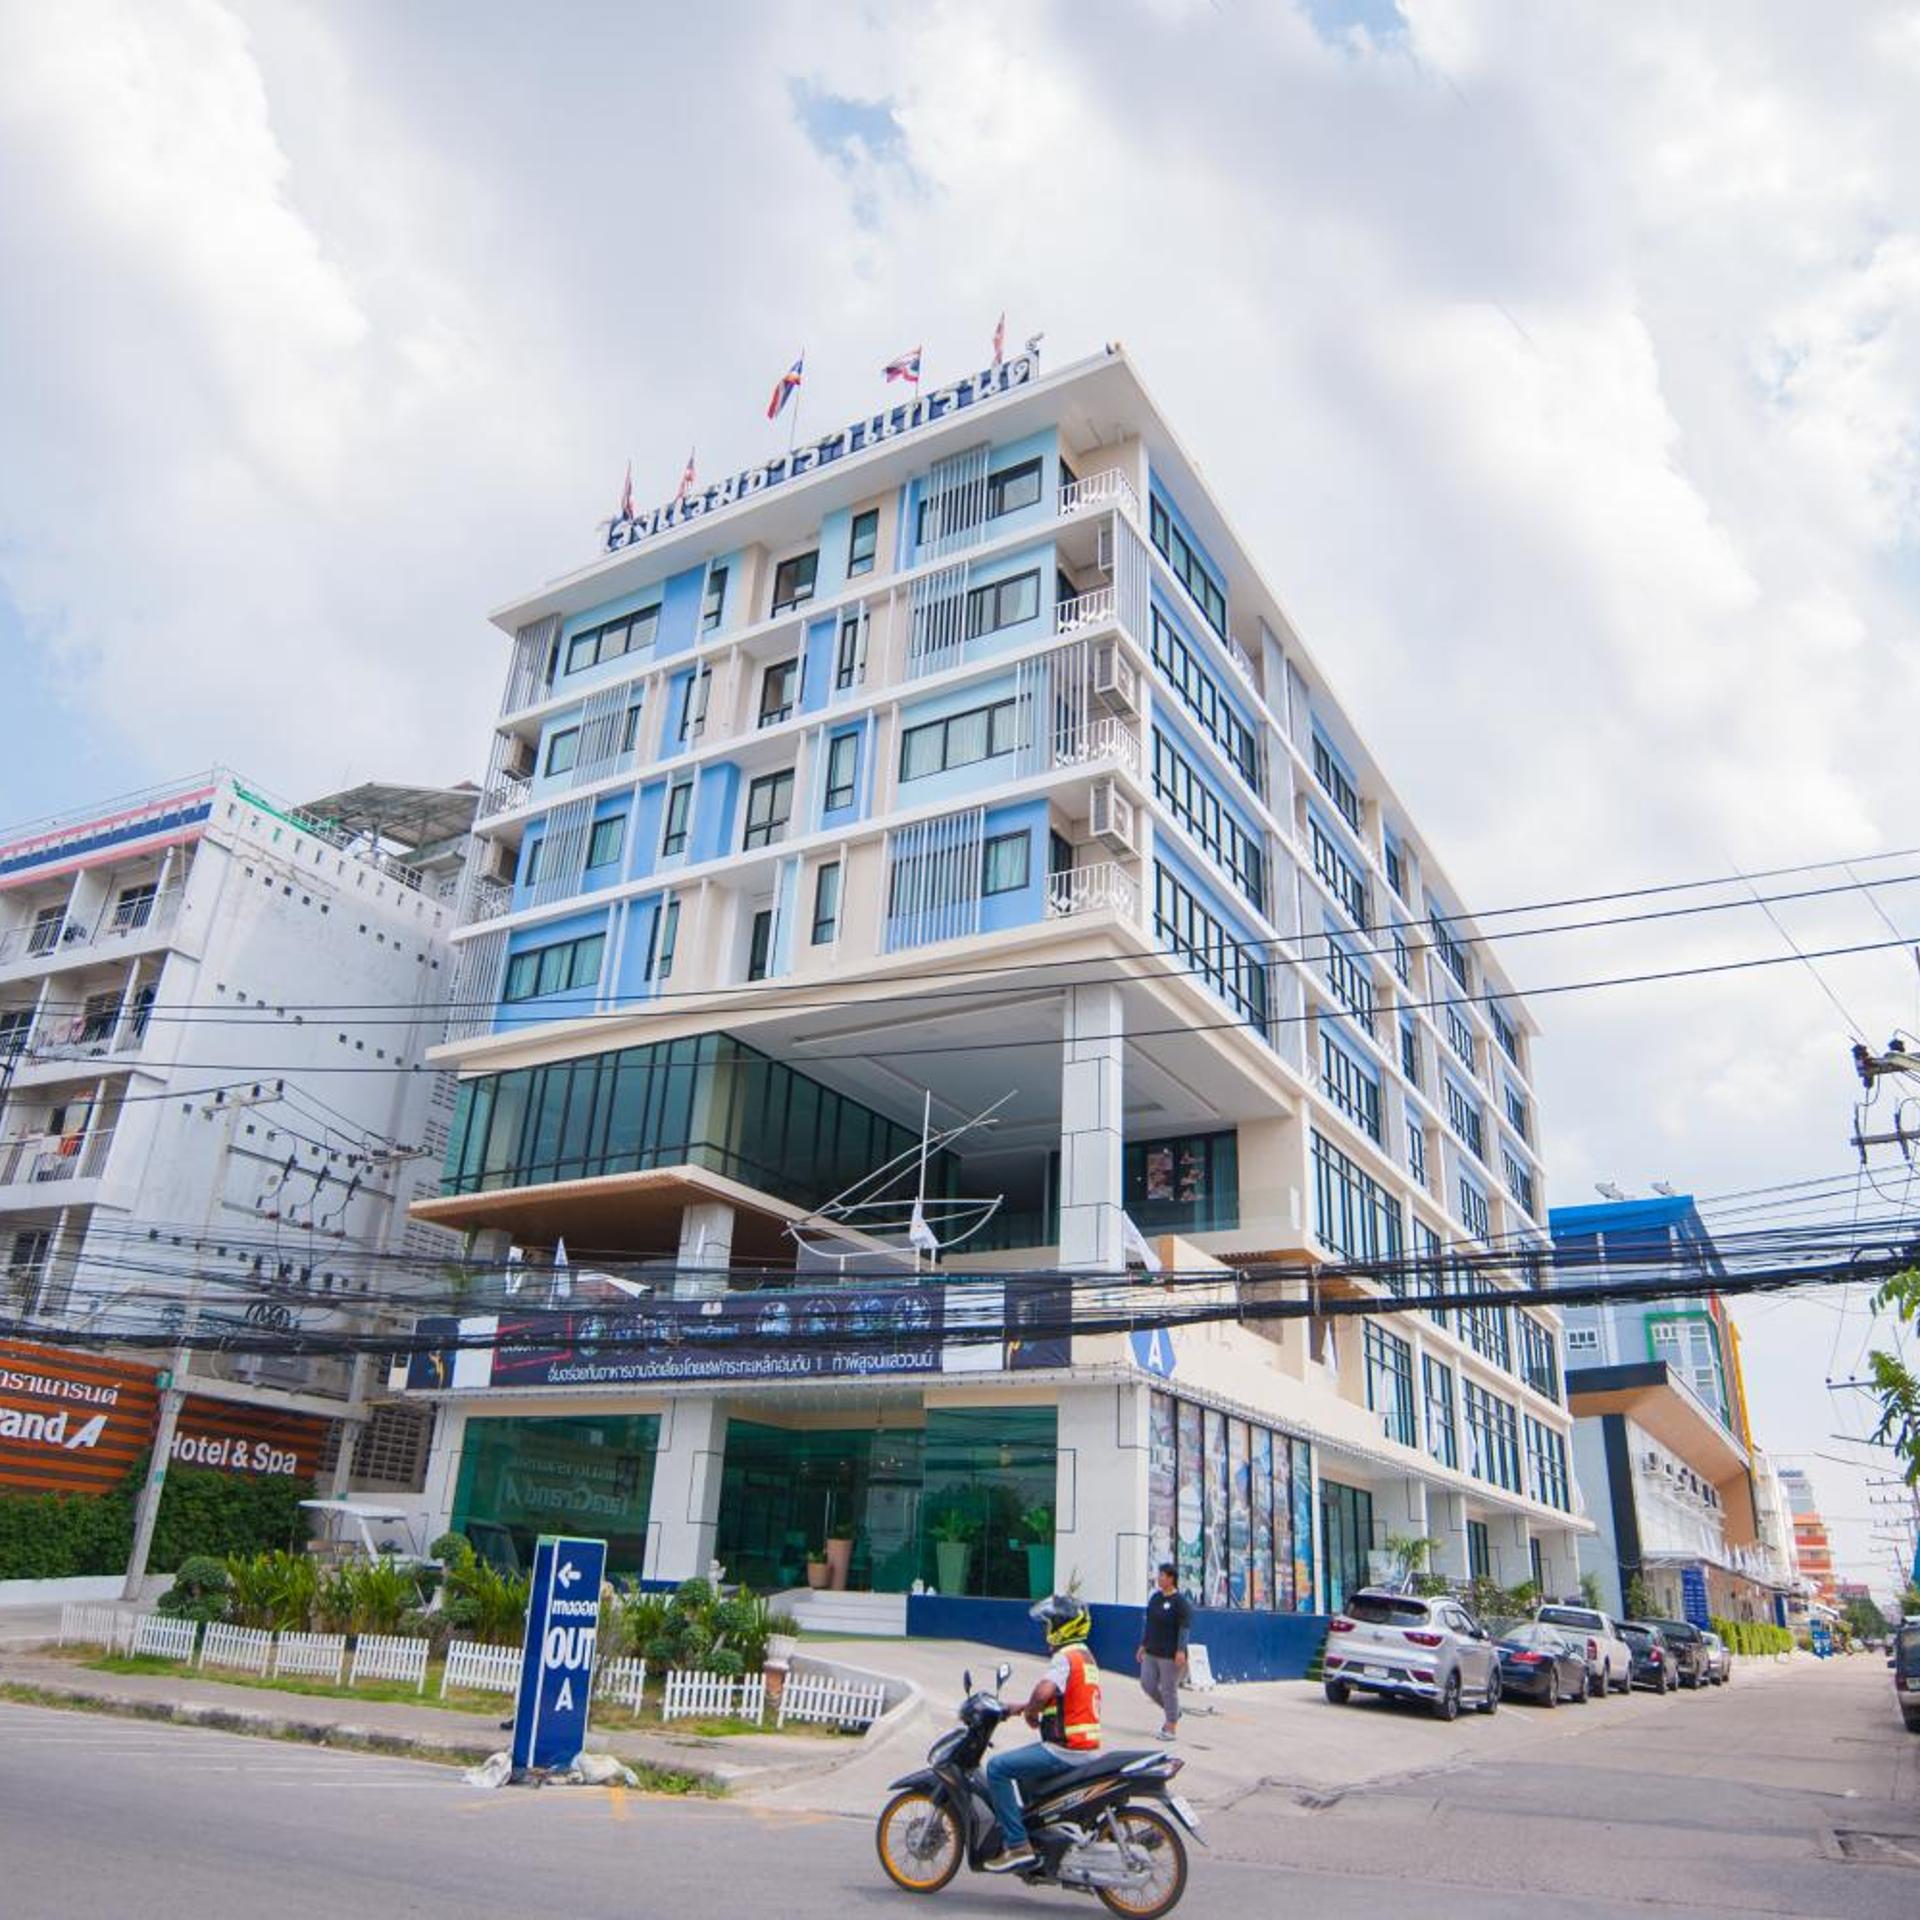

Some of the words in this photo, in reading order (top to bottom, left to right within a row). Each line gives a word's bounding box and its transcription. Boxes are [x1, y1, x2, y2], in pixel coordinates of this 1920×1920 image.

[170, 1432, 230, 1466] Hotel
[231, 1440, 248, 1468] &
[252, 1443, 297, 1475] Spa
[546, 1626, 597, 1671] OUT
[554, 1677, 574, 1711] A
